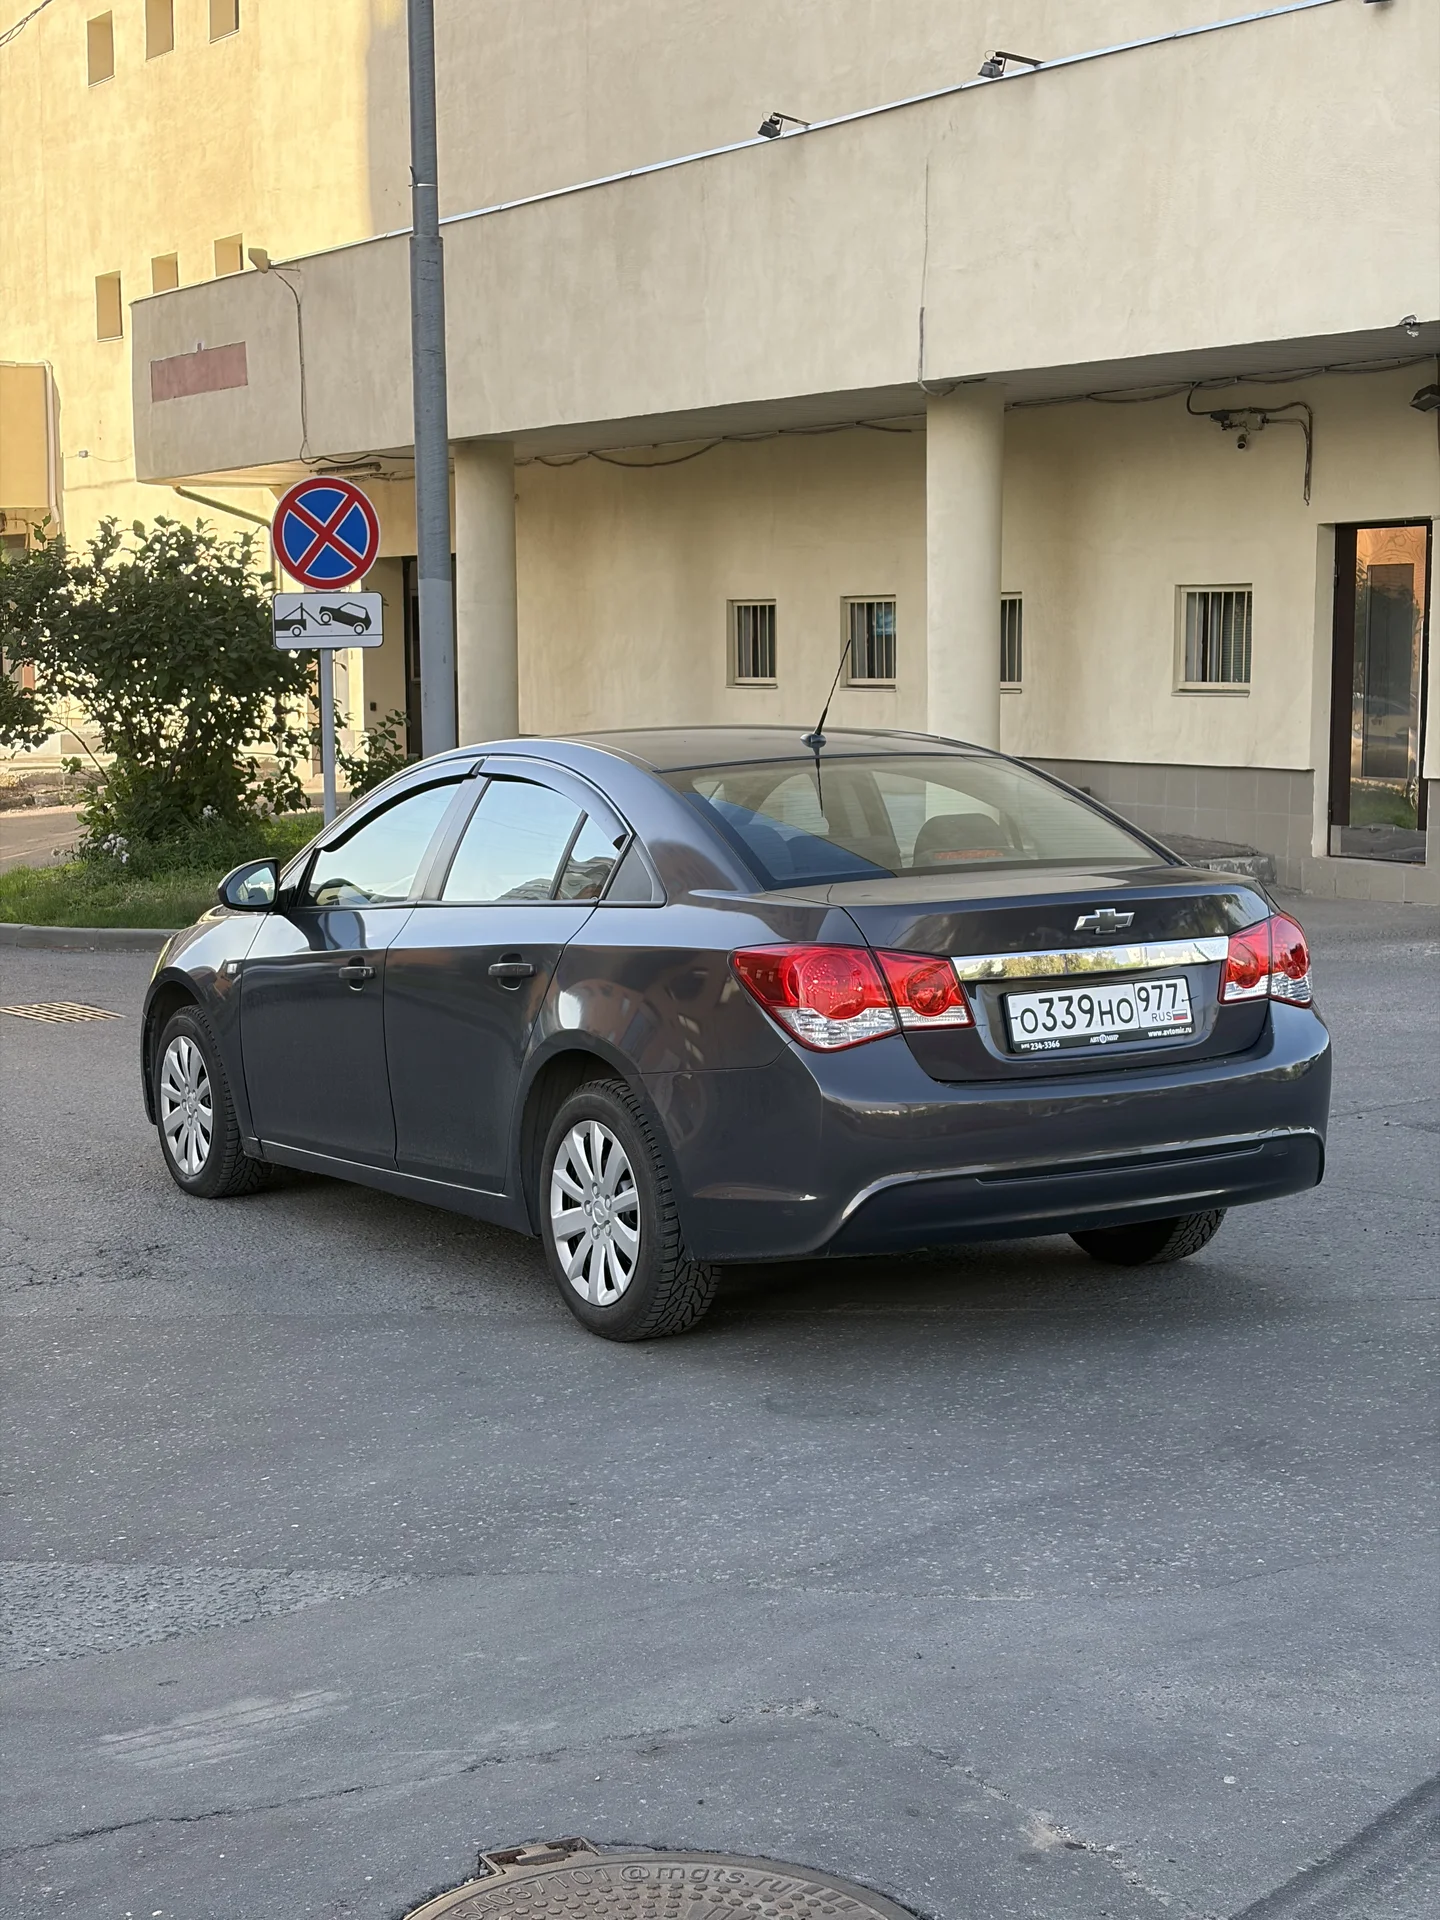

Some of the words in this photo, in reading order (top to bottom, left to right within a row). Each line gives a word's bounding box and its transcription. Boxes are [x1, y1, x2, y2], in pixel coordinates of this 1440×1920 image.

[1137, 982, 1178, 1012] 977
[1151, 1011, 1173, 1022] RUS
[1147, 1026, 1192, 1038] www.avtomir.ru
